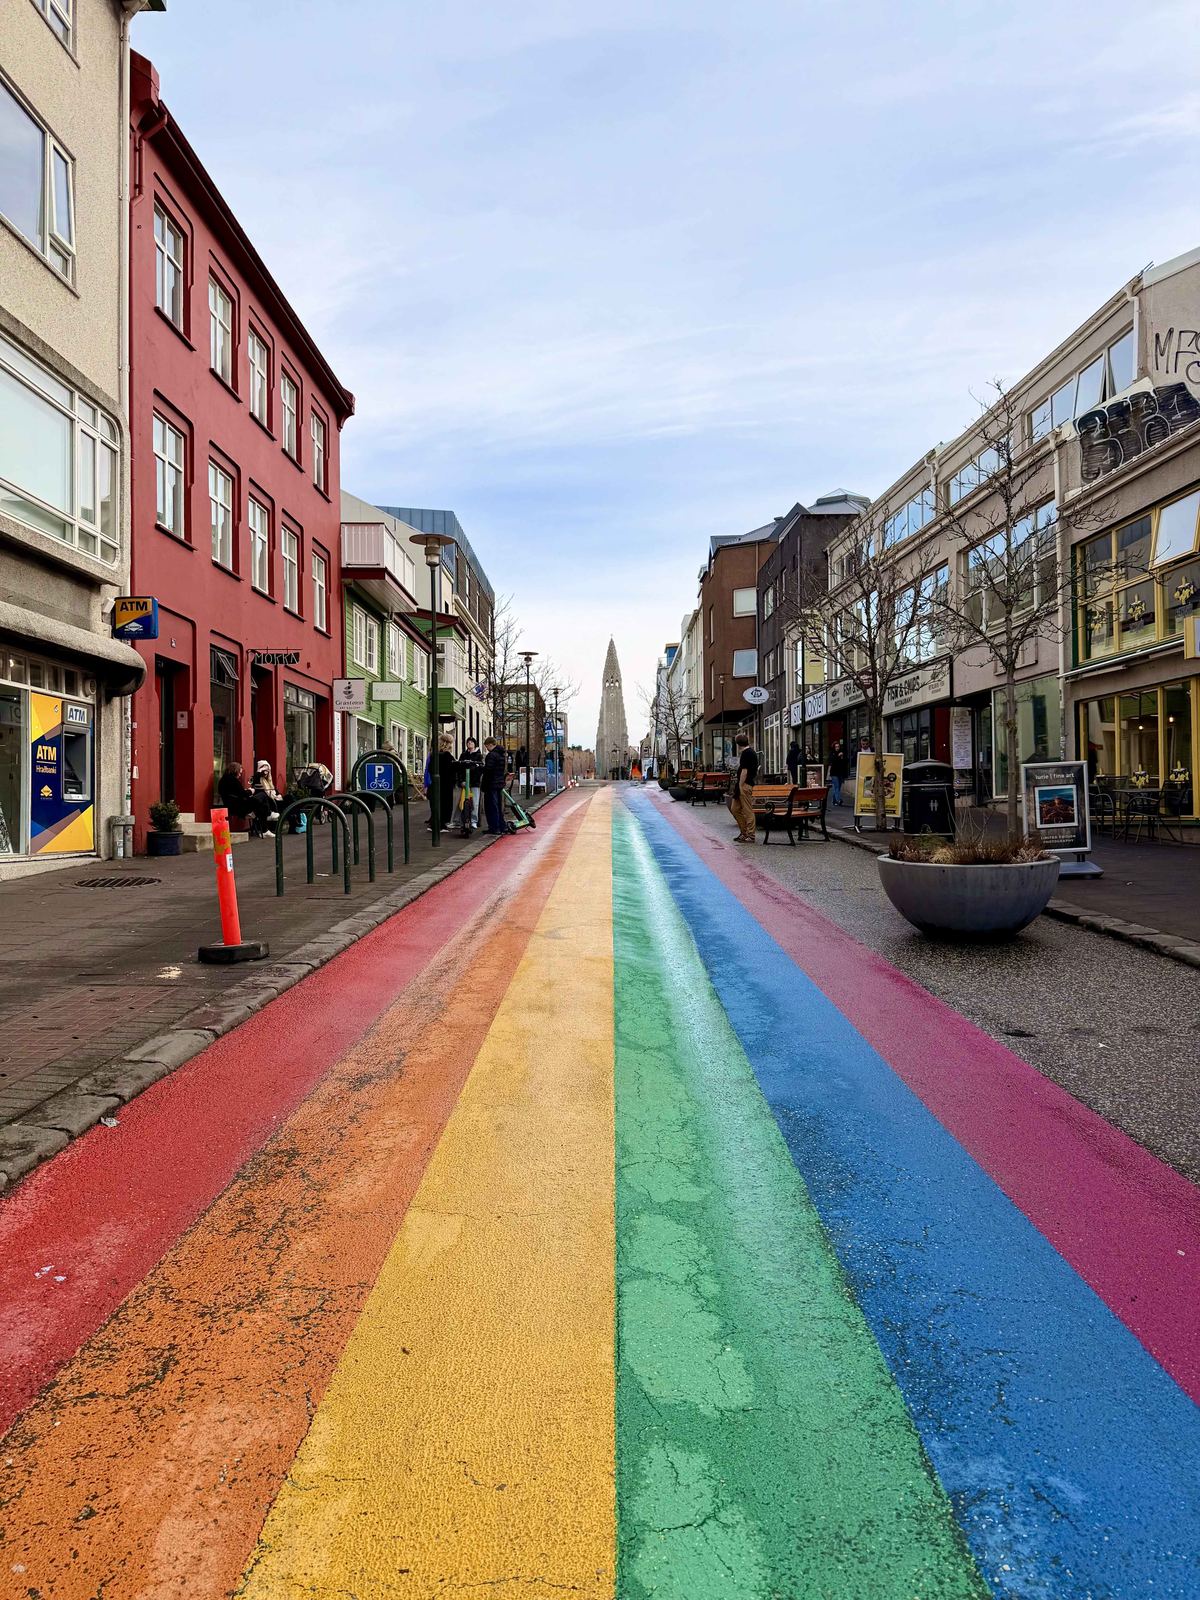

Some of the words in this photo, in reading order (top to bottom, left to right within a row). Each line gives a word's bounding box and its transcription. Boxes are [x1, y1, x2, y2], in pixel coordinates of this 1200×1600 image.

[120, 601, 148, 612] ATM
[254, 652, 299, 665] MOKKA
[68, 707, 86, 722] ATM
[36, 744, 57, 761] ATM
[375, 765, 385, 778] P
